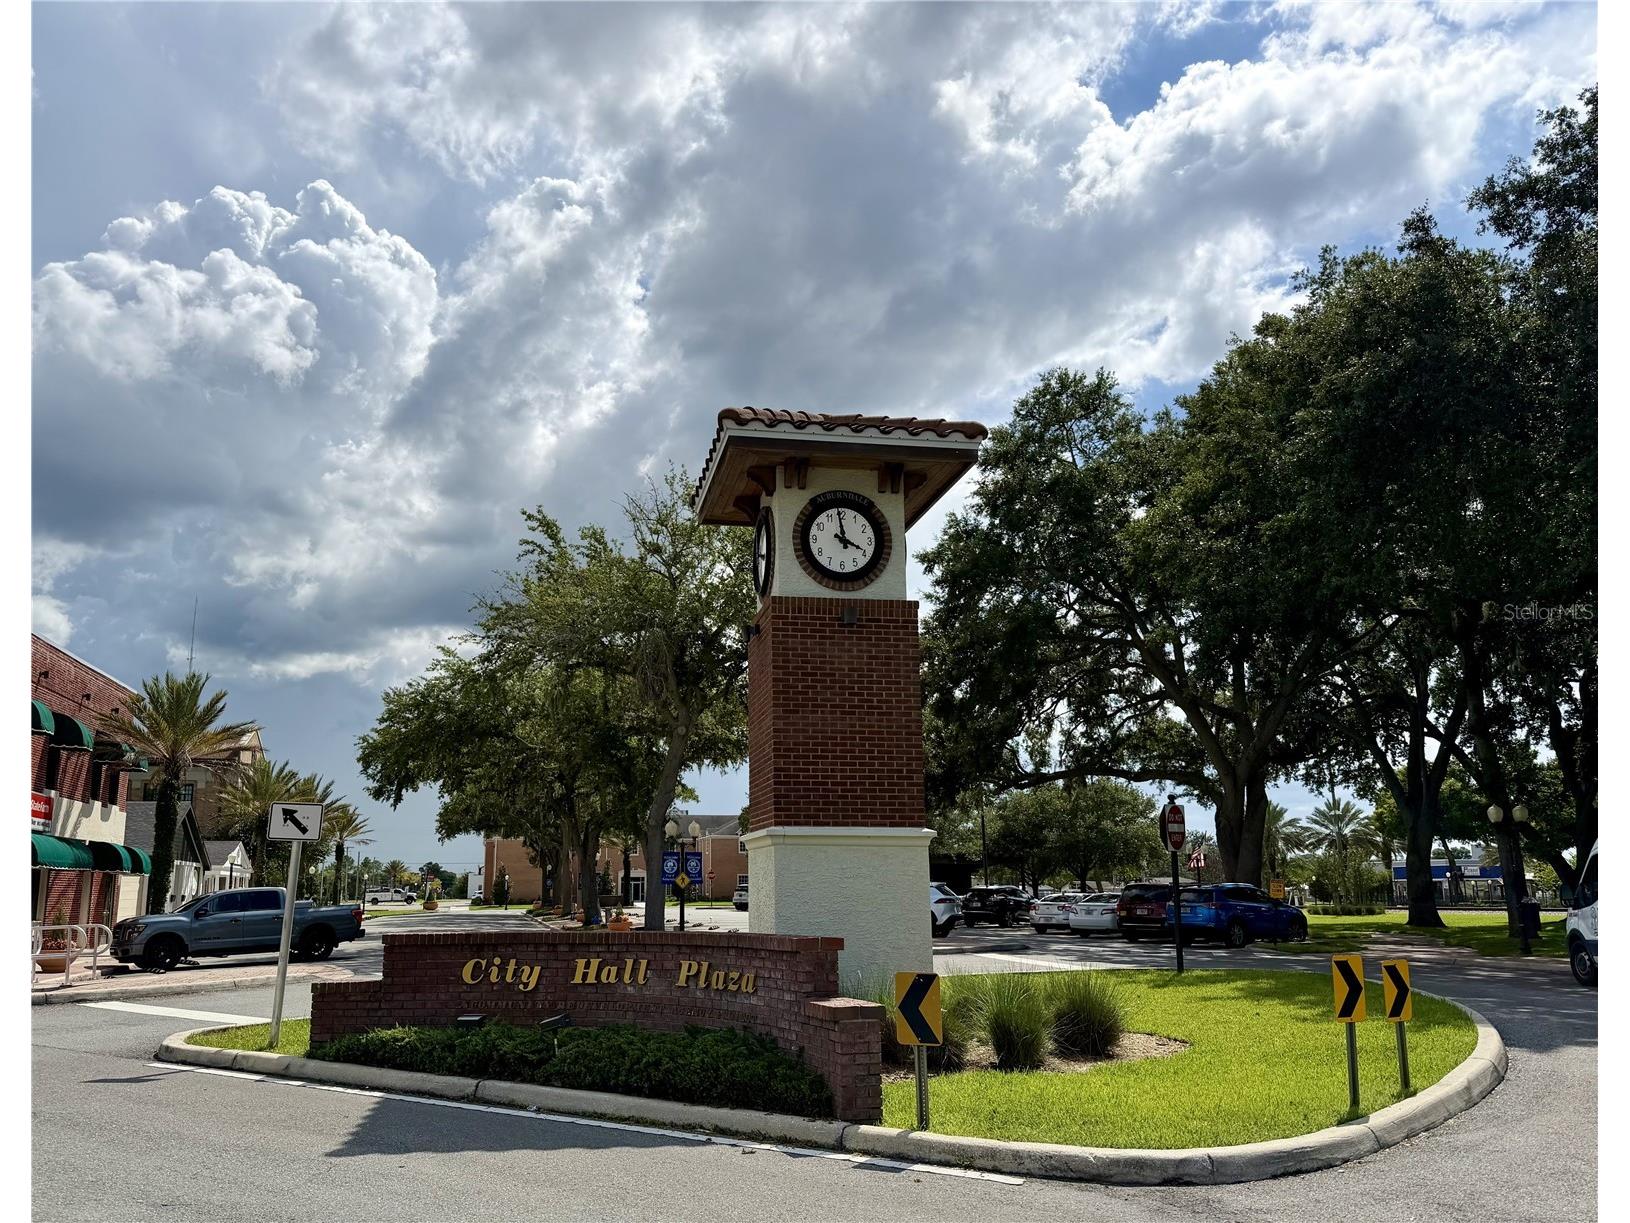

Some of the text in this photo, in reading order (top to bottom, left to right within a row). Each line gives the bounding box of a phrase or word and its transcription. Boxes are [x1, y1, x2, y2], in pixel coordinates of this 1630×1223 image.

[816, 491, 869, 506] AUBURNDALE
[826, 513, 834, 523] 11
[852, 514, 858, 524] 1
[816, 522, 825, 531] 10
[861, 524, 867, 534] 2
[812, 534, 818, 544] 9
[867, 537, 873, 546] 3
[817, 547, 823, 557] 8
[861, 548, 867, 558] 4
[827, 556, 833, 567] 7
[839, 560, 846, 571] 6
[852, 558, 859, 568] 5
[1175, 813, 1183, 822] NOT
[1171, 834, 1183, 842] ENTER
[461, 957, 757, 993] City Hall Plaza
